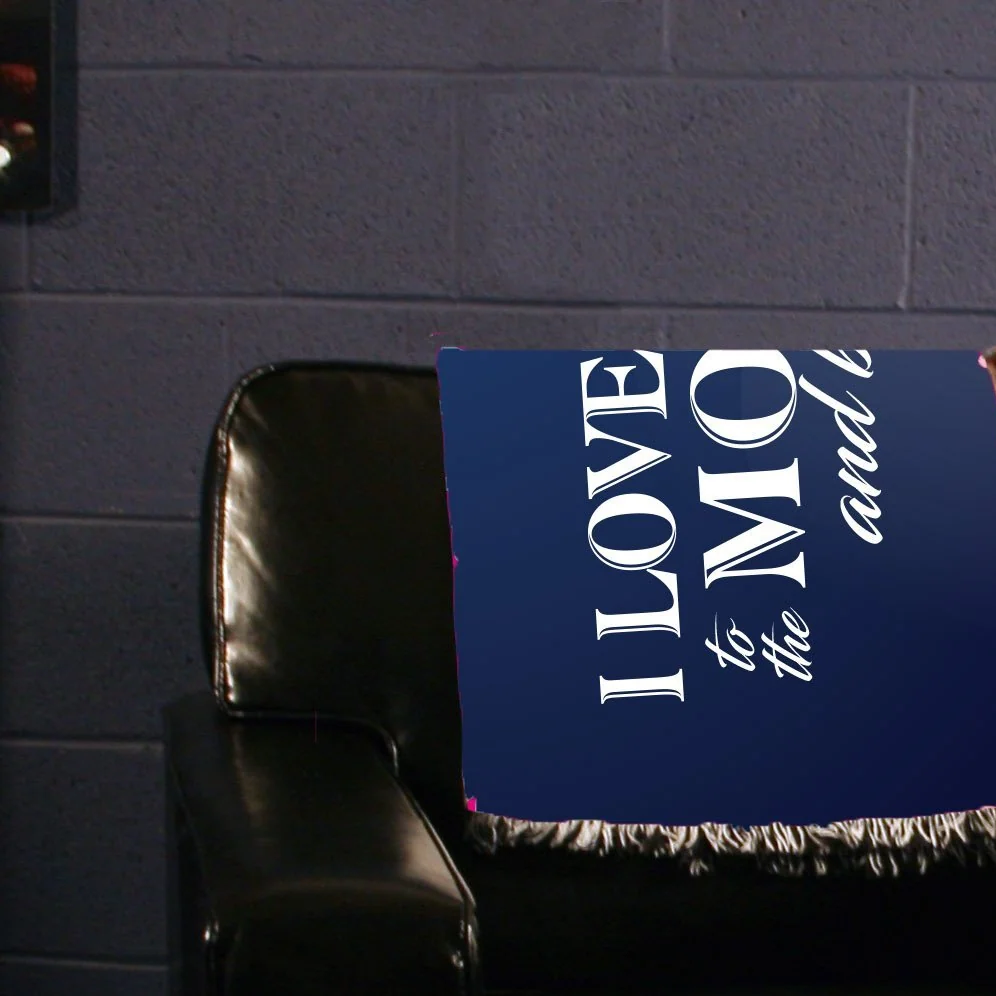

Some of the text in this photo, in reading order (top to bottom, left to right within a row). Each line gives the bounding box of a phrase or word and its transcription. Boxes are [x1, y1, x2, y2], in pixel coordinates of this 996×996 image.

[580, 350, 684, 704] I LOVE
[690, 350, 805, 588] MO
[799, 374, 883, 544] and
[705, 612, 755, 672] to
[761, 607, 812, 682] the
